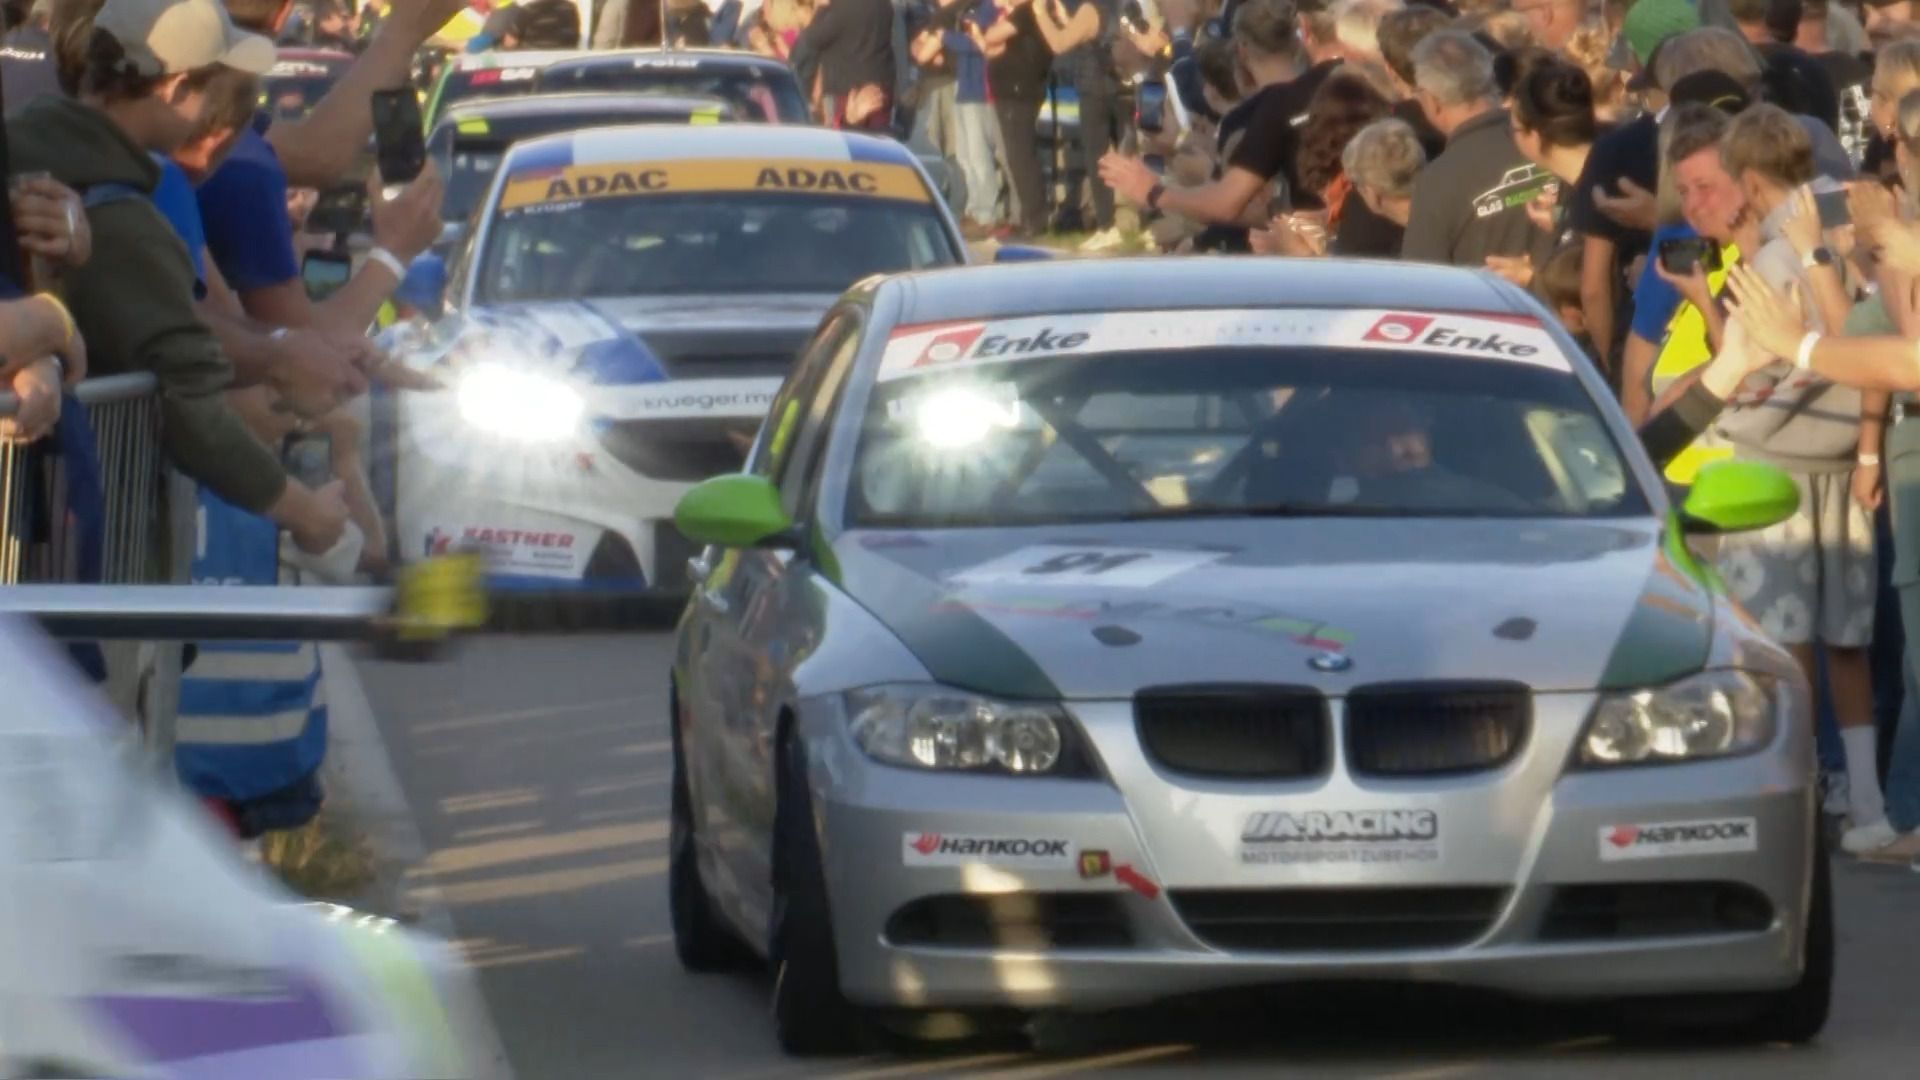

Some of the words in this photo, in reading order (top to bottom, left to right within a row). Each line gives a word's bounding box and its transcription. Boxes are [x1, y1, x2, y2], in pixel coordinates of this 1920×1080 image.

[546, 169, 669, 198] ADAC
[755, 167, 879, 193] ADAC
[971, 326, 1091, 358] Enke
[1422, 327, 1539, 357] Enke
